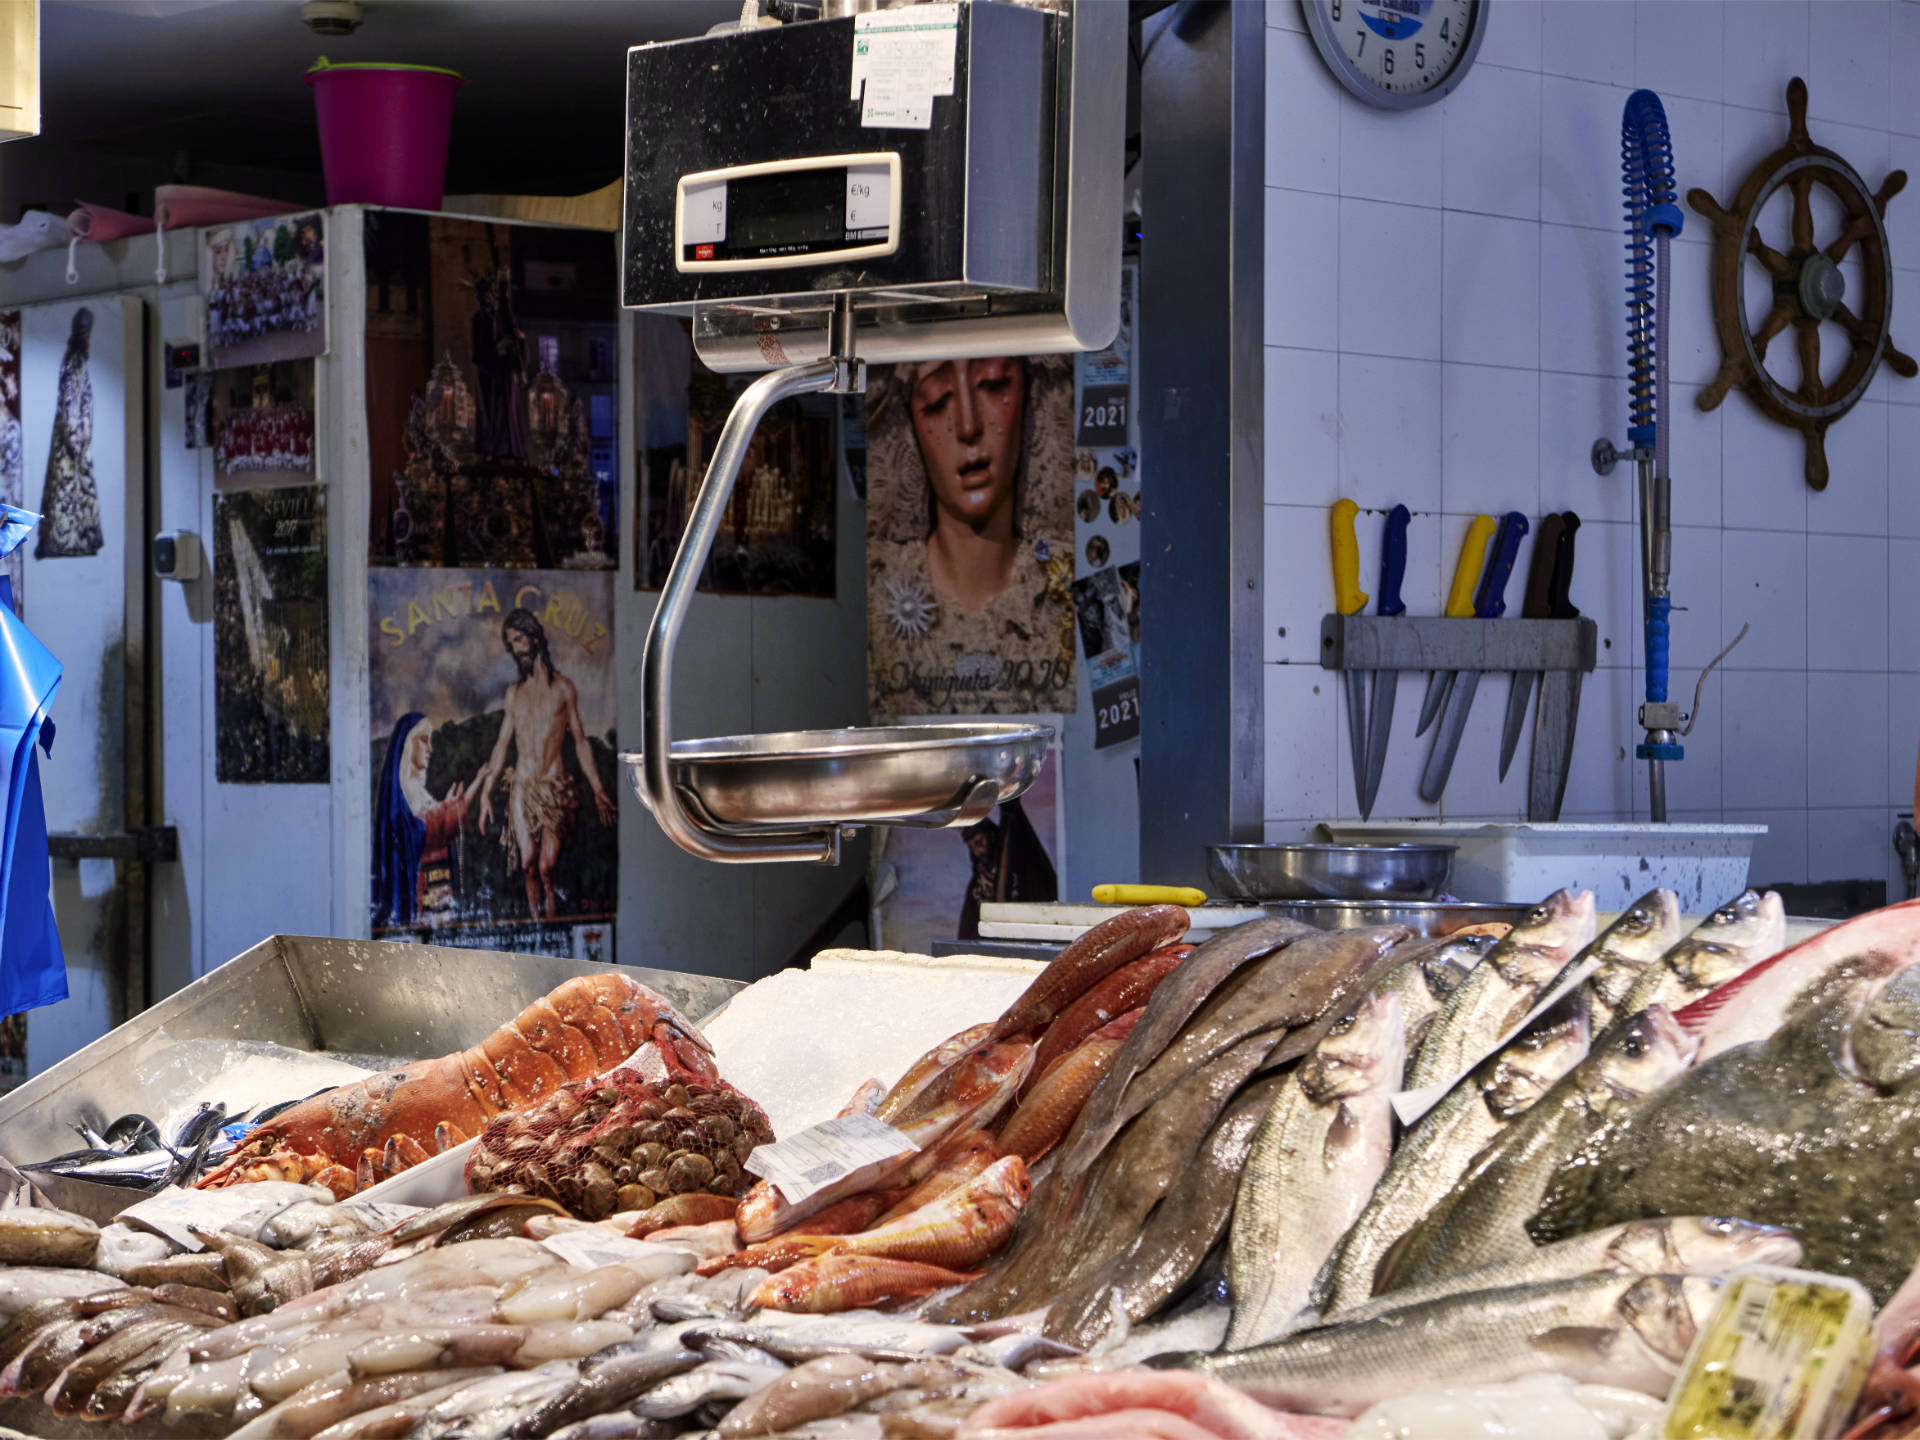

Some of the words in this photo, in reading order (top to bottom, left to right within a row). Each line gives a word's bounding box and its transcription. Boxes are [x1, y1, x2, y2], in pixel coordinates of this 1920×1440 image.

[1440, 17, 1449, 43] 4
[1357, 31, 1366, 57] 7
[1415, 43, 1425, 69] 5
[1384, 49, 1394, 75] 6
[850, 184, 871, 198] €/kg
[712, 199, 722, 212] kg
[850, 211, 857, 223] €
[1084, 405, 1127, 428] 2021
[380, 580, 501, 647] SANTA
[514, 584, 608, 656] CRUZ
[1098, 696, 1140, 730] 2021
